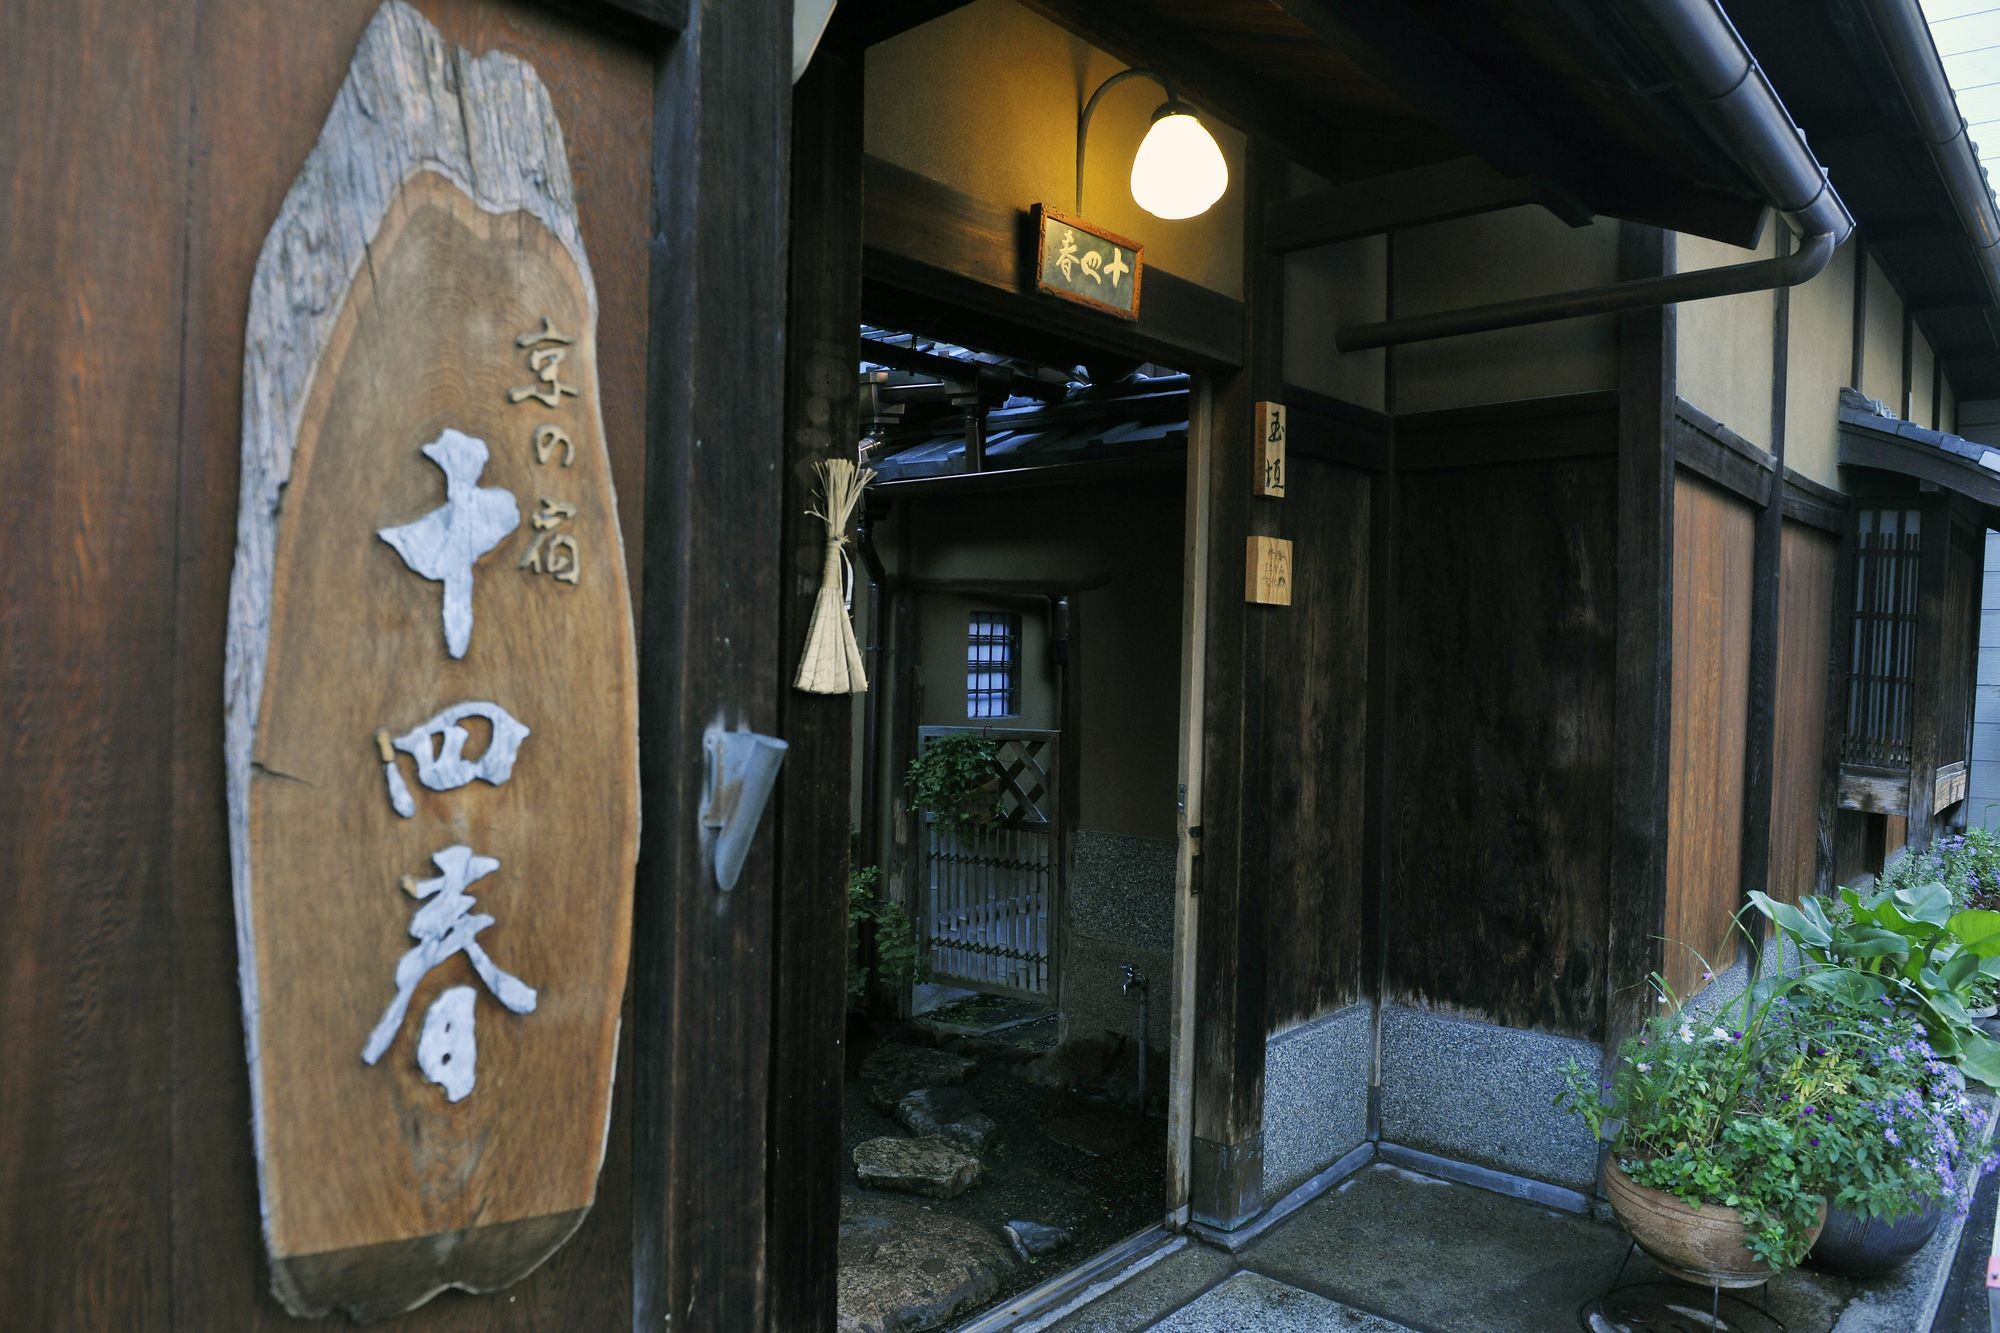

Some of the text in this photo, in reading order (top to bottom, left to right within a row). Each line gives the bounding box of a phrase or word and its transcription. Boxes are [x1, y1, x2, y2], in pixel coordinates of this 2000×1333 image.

[508, 316, 580, 585] 京の宿
[1265, 411, 1285, 489] 玉垣
[362, 428, 537, 1103] 十四春
